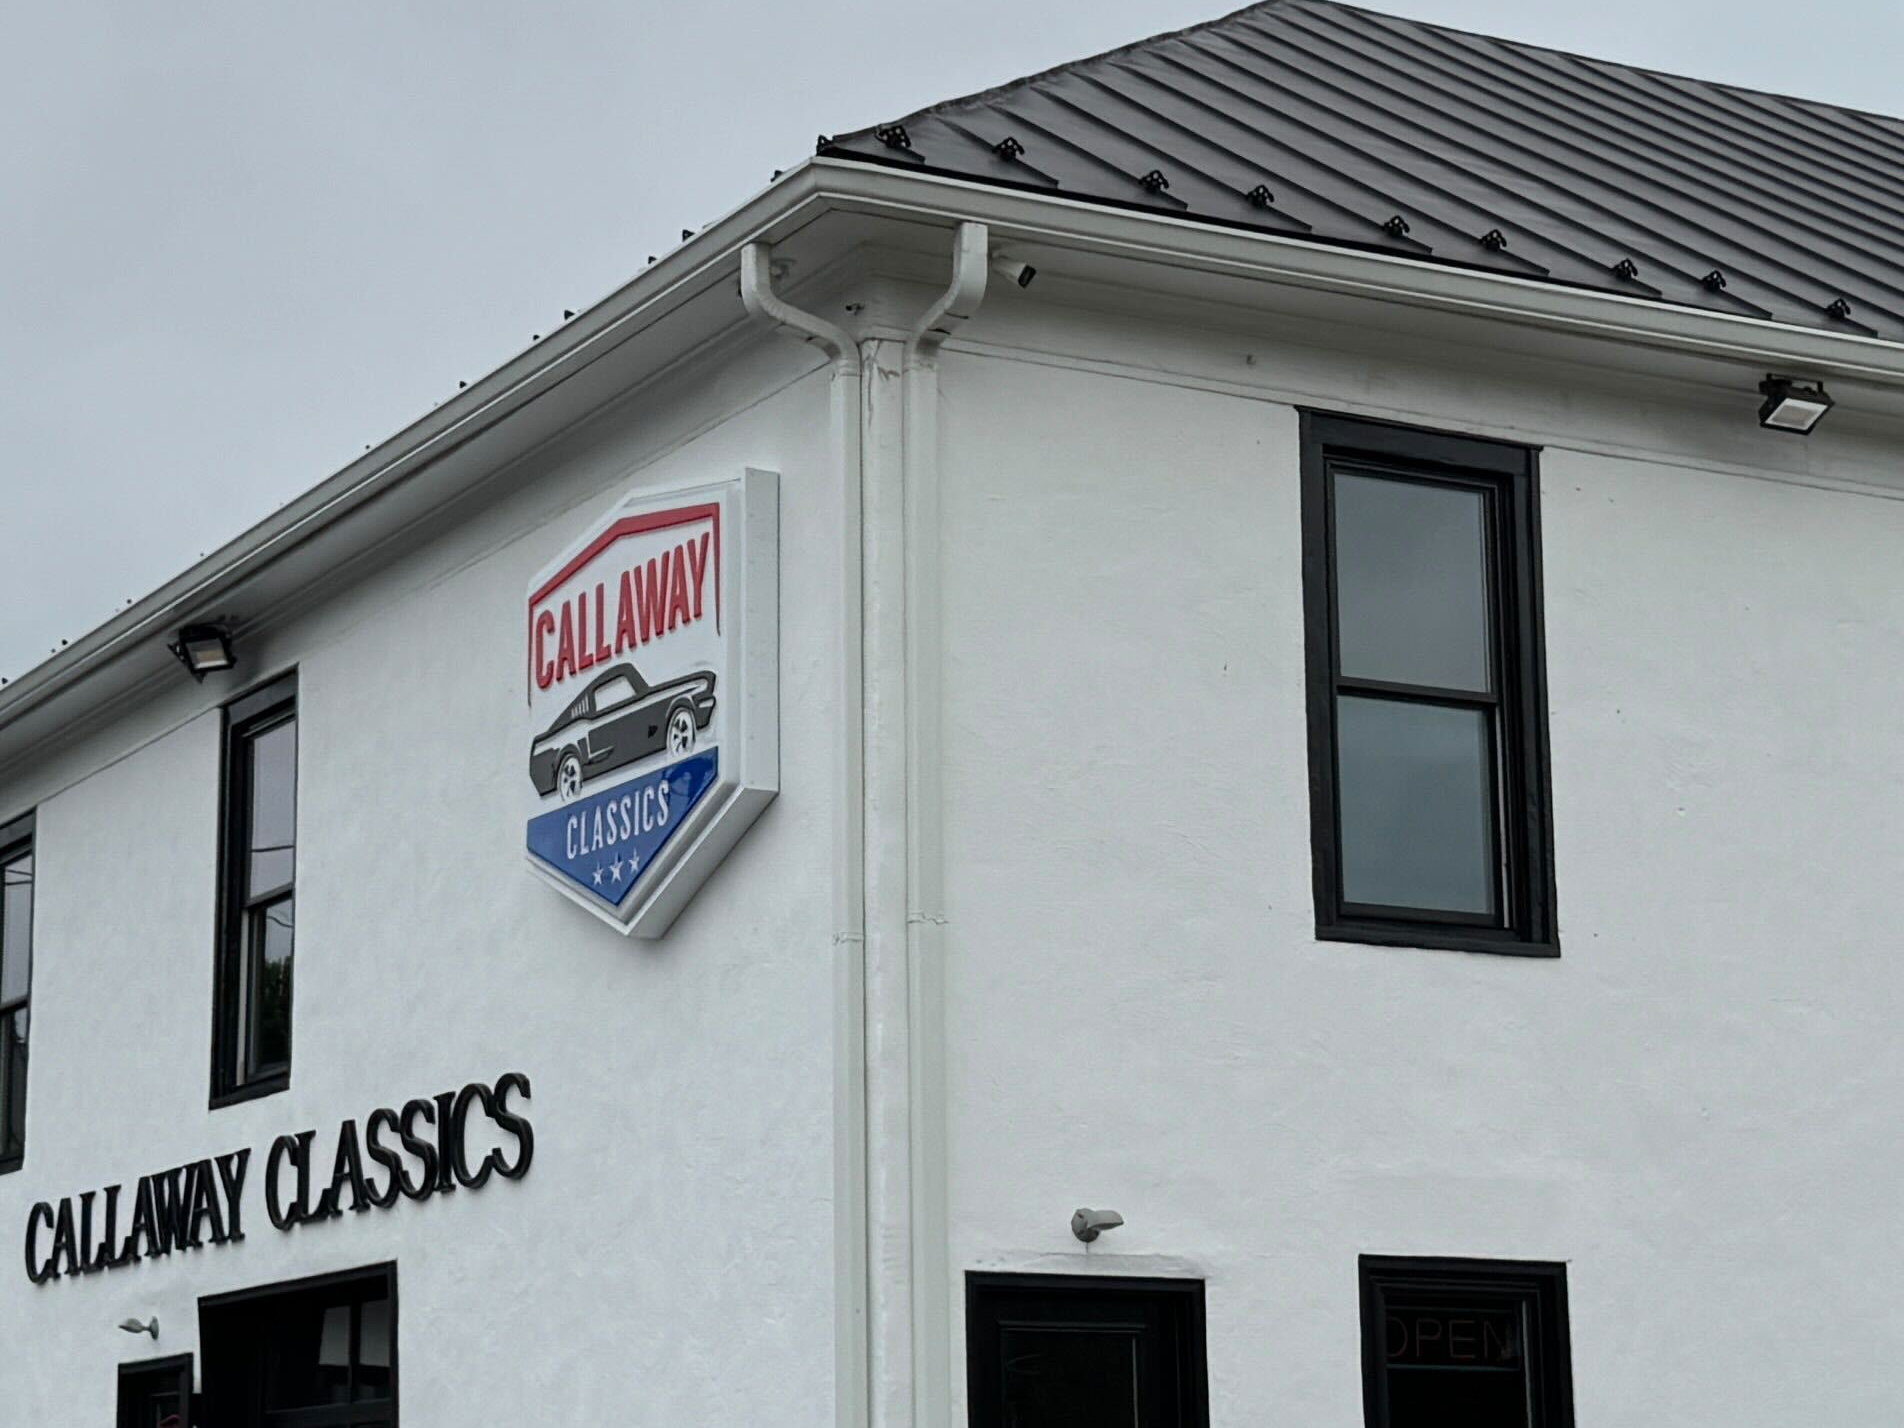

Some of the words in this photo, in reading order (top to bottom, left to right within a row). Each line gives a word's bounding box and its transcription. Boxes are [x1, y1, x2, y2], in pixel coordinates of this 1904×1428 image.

[533, 531, 711, 691] CALLAWAY
[565, 779, 671, 860] CLASSICS
[24, 1147, 252, 1285] CALLAWAY
[265, 1072, 535, 1232] CLASSICS
[1386, 1316, 1513, 1362] OPEN
